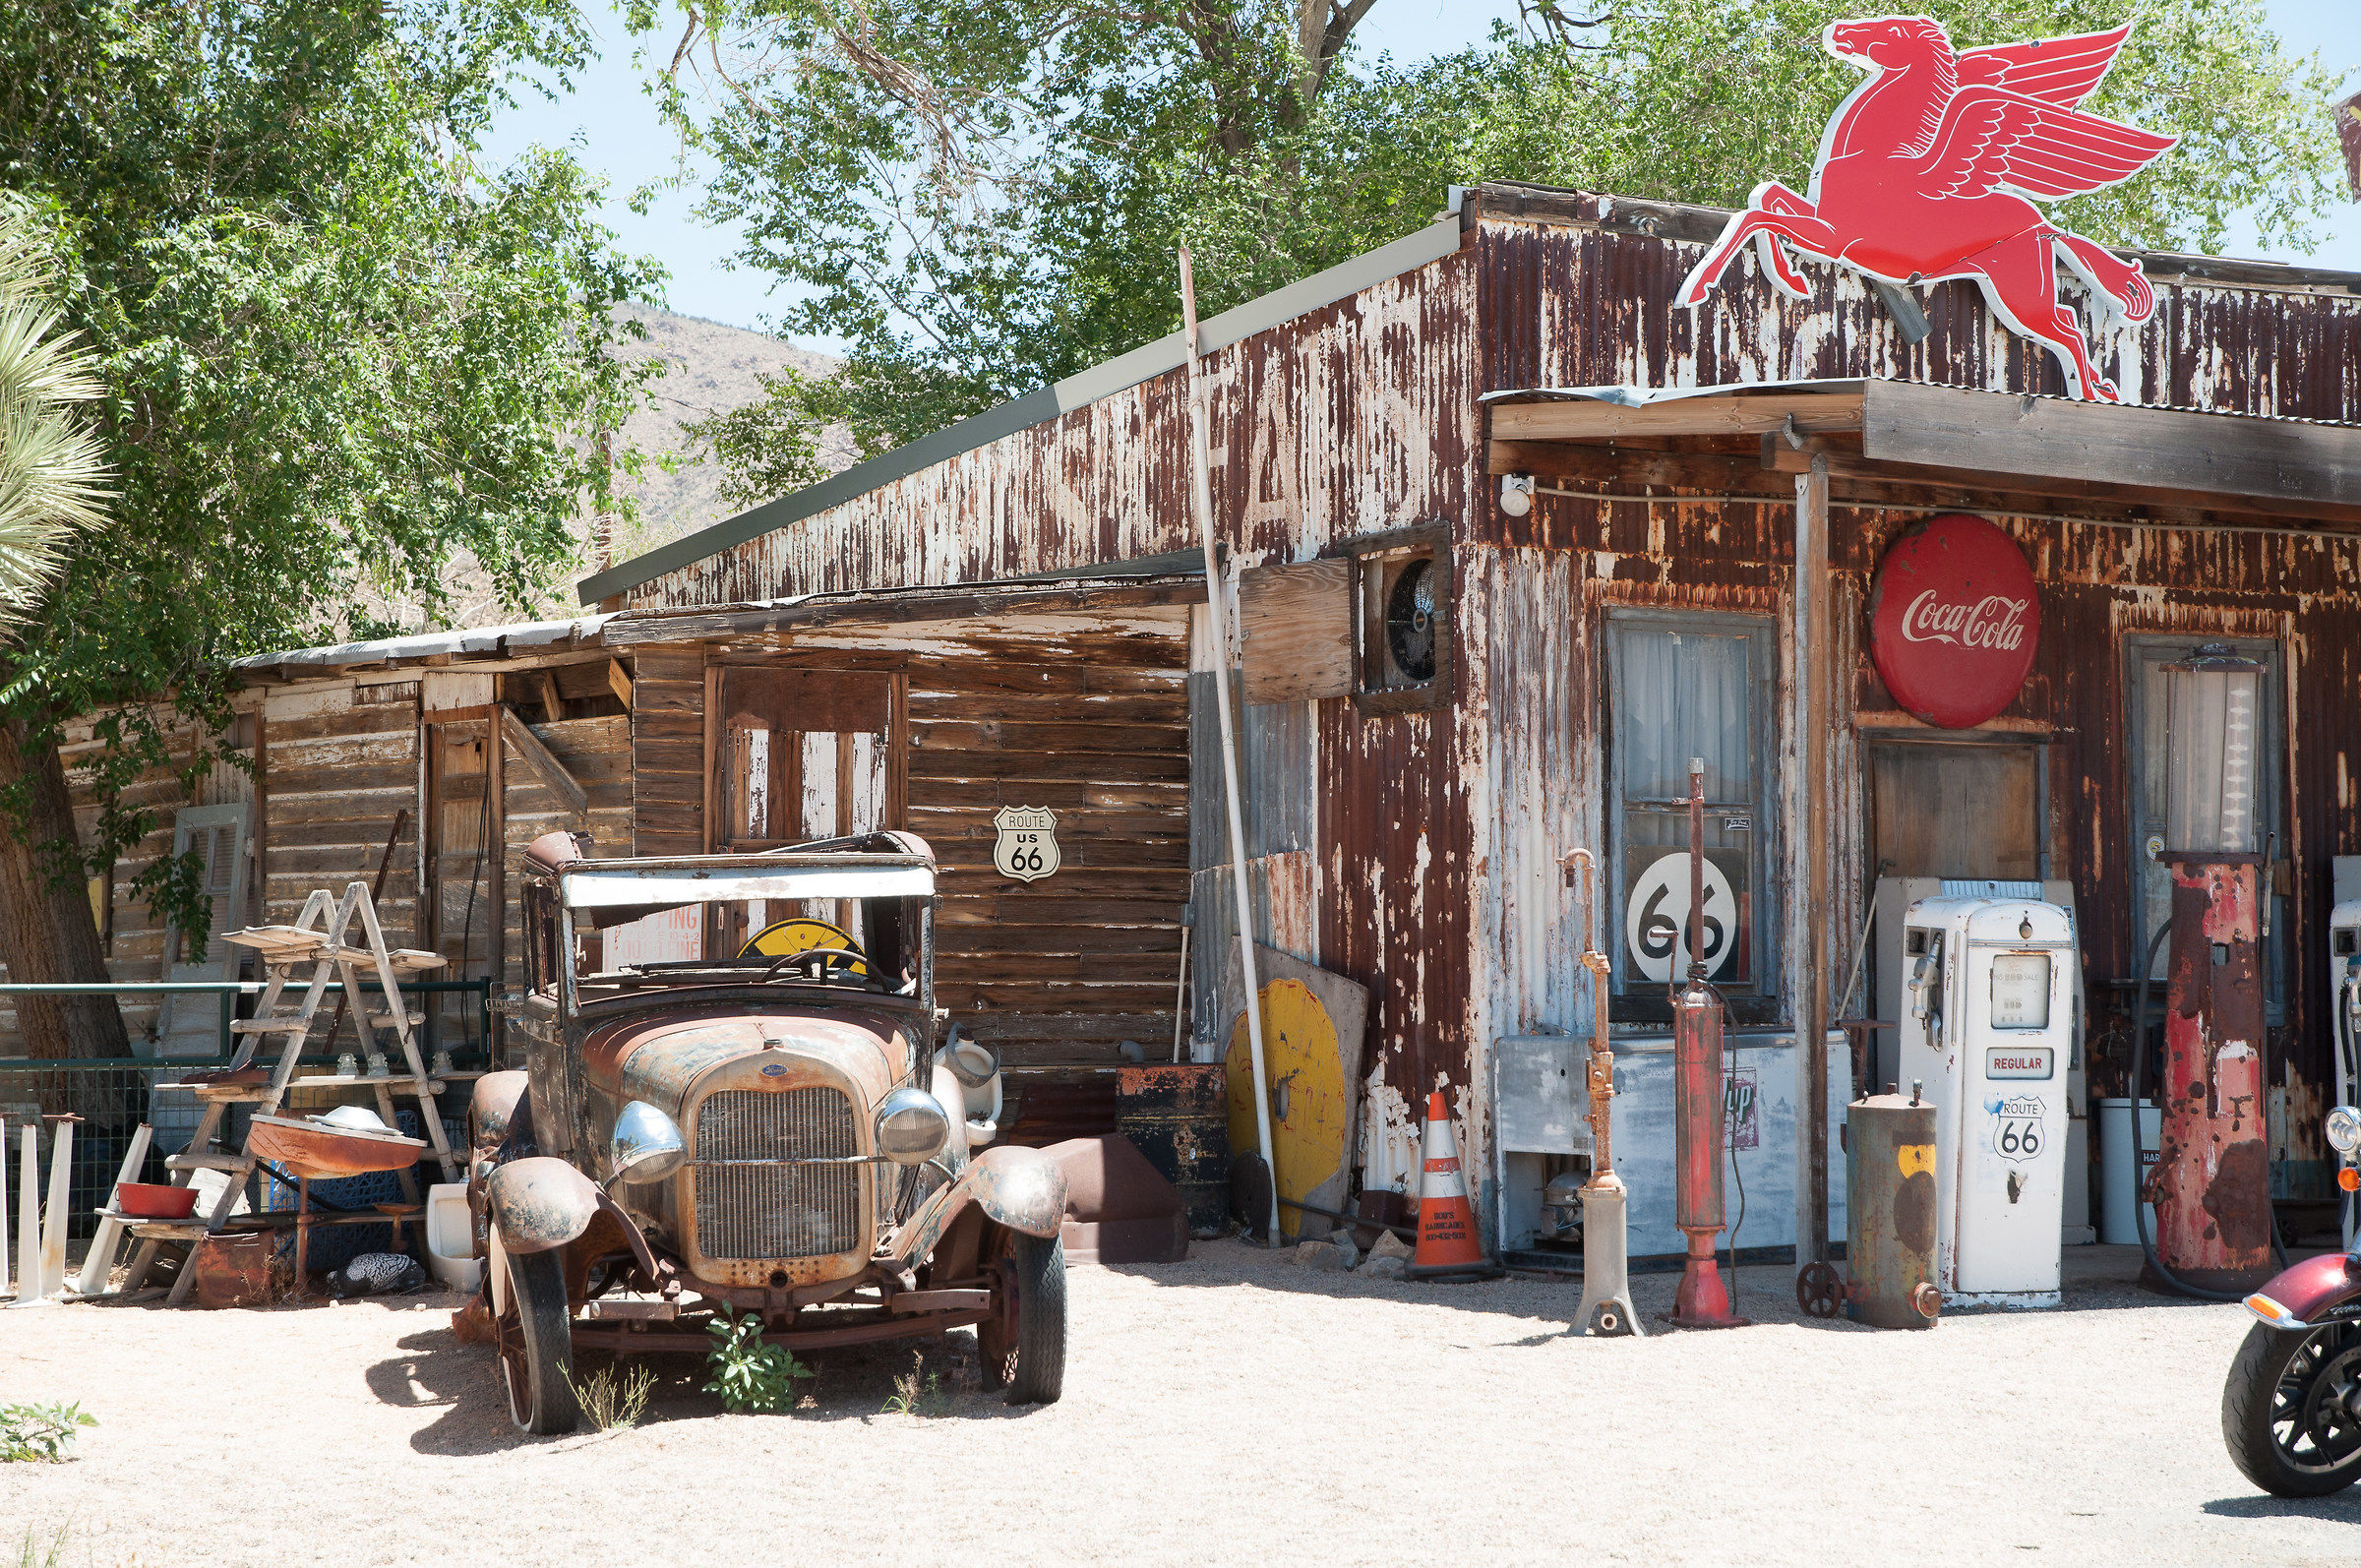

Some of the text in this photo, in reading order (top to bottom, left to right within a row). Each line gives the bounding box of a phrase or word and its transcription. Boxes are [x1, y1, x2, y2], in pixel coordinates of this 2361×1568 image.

[1902, 589, 2029, 650] Coca-Cola
[1008, 815, 1045, 827] ROUTE
[1016, 833, 1038, 843] US
[1011, 846, 1043, 872] 66
[1638, 882, 1724, 959] 66
[1994, 1057, 2042, 1069] REGULAR
[2004, 1103, 2038, 1115] ROUTE
[2001, 1120, 2038, 1153] 66
[2143, 1152, 2160, 1163] HAR
